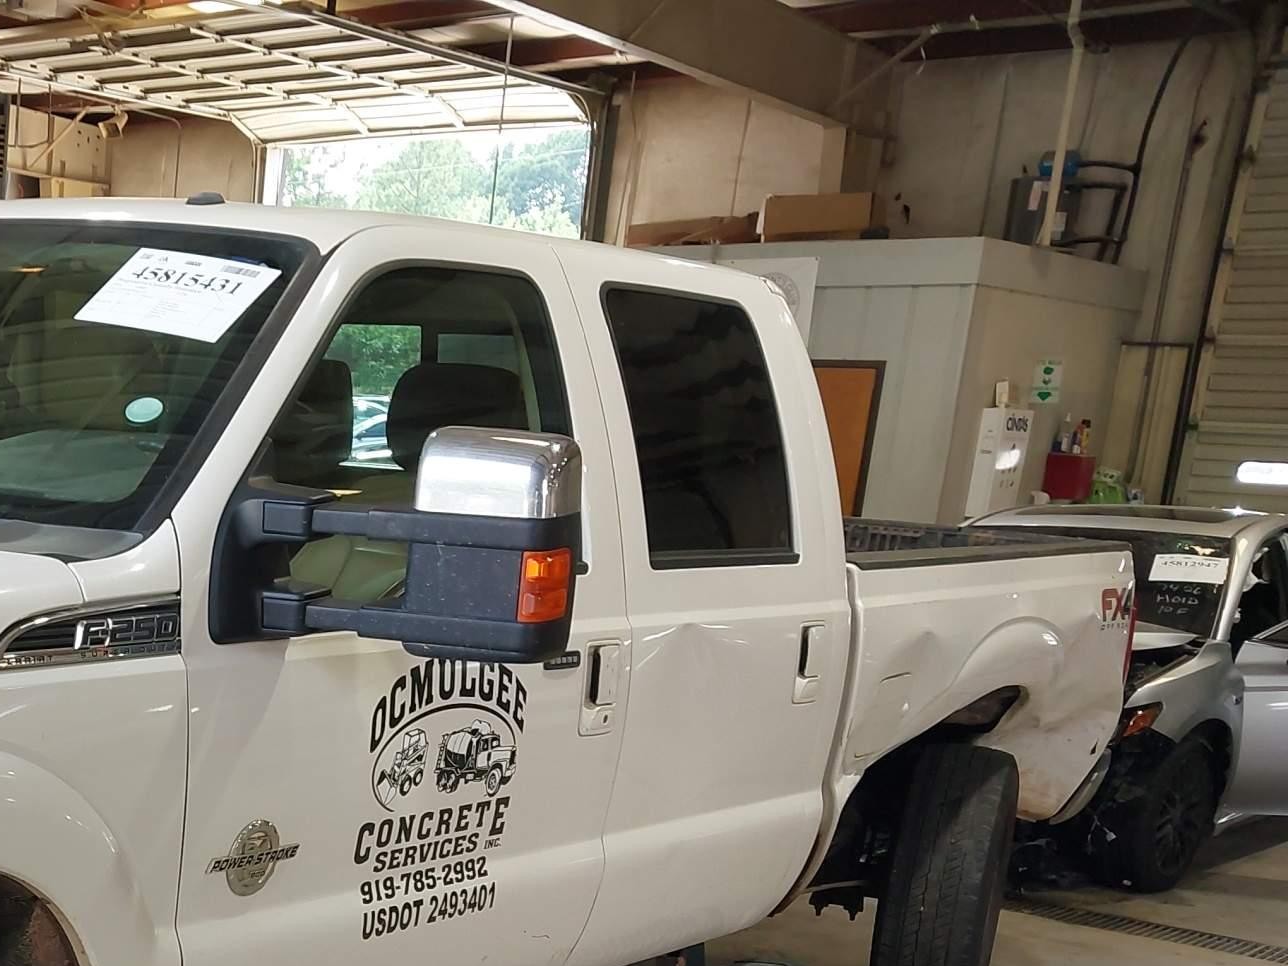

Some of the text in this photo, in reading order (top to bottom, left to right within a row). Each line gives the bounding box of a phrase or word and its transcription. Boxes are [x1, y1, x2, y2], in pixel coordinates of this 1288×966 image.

[132, 266, 243, 294] 45815431
[370, 657, 527, 753] OCMULGEE
[354, 796, 510, 864] CONCRETE
[372, 832, 502, 873] SERVICES INC.
[360, 855, 488, 905] 919-785-2992
[362, 881, 496, 940] USDOT 2493401
